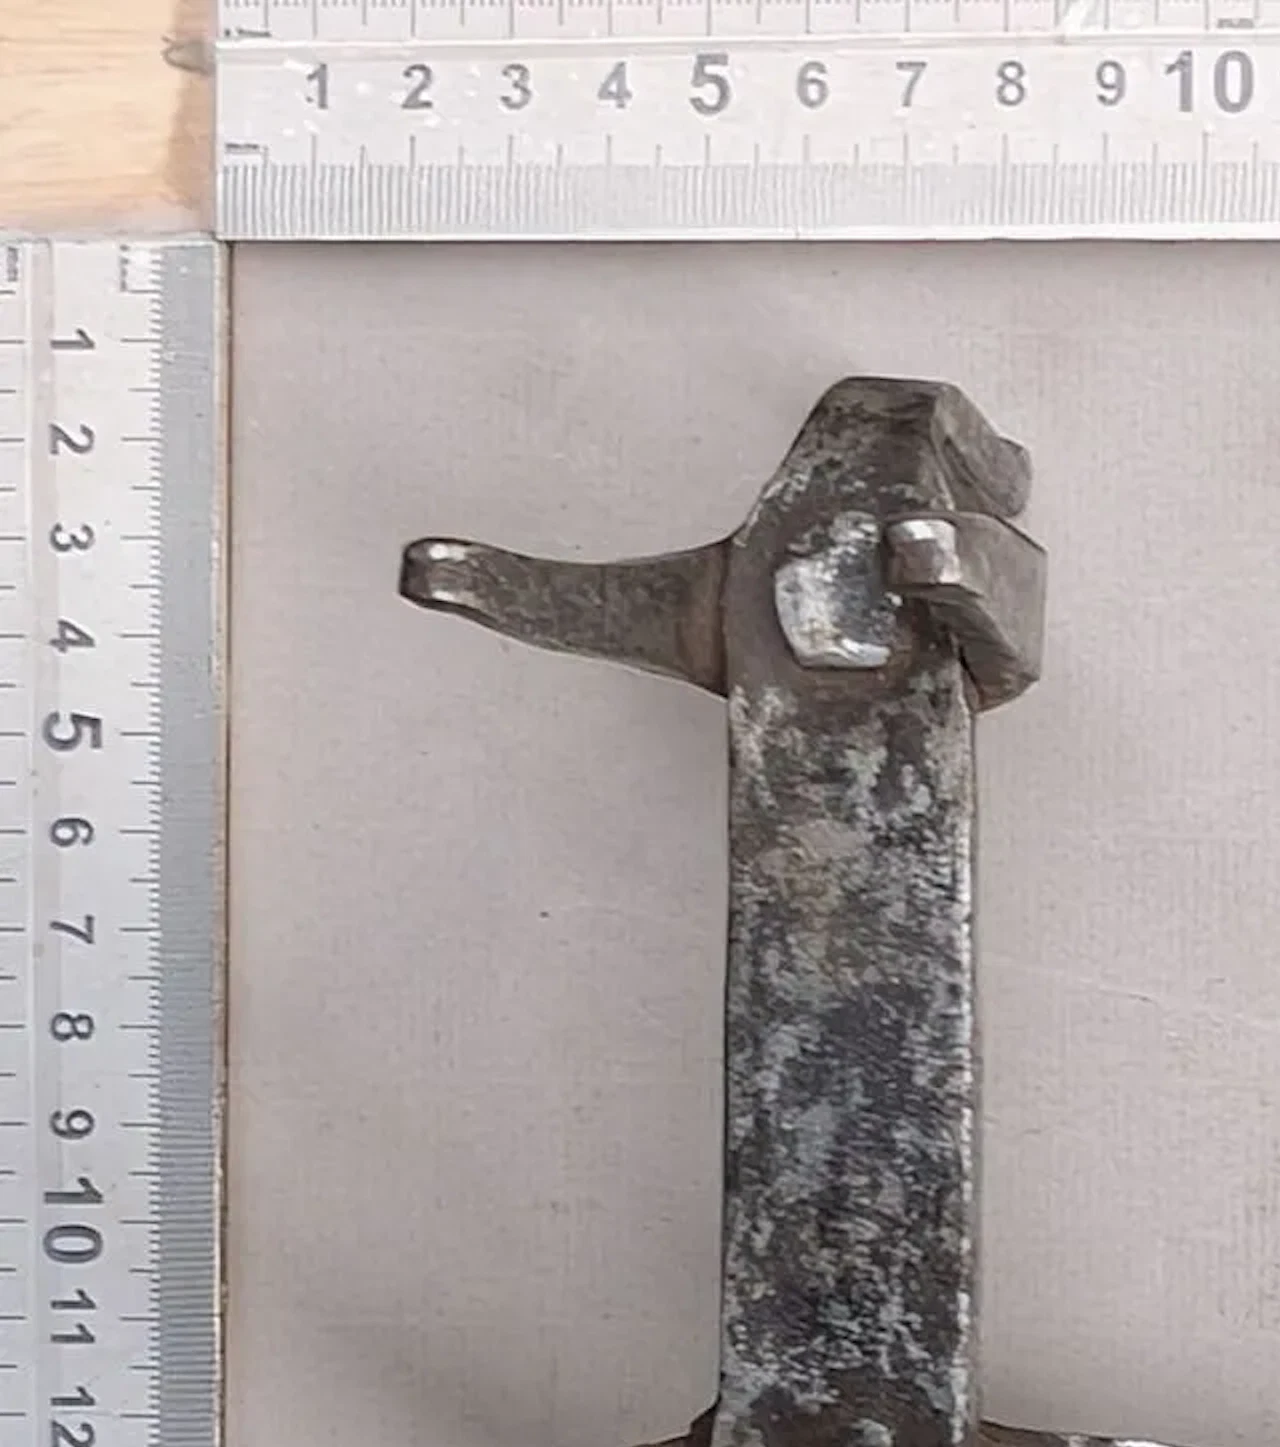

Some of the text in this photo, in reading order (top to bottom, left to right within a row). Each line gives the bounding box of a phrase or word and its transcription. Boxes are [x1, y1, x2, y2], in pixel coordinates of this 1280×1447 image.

[306, 61, 328, 110] 1
[400, 64, 433, 110] 2
[500, 64, 532, 110] 3
[597, 62, 632, 109] 4
[689, 52, 730, 115] 5
[796, 61, 828, 109] 6
[896, 61, 927, 107] 7
[996, 60, 1026, 106] 8
[1096, 60, 1125, 106] 9
[1165, 50, 1253, 113] 10
[48, 328, 95, 350] 1
[47, 423, 95, 456] 2
[48, 522, 96, 552] 3
[47, 619, 96, 653] 4
[41, 710, 103, 752] 5
[48, 817, 94, 848] 6
[48, 914, 95, 944] 7
[48, 1012, 95, 1042] 8
[48, 1109, 95, 1140] 9
[42, 1177, 104, 1264] 10
[50, 1288, 97, 1344] 11
